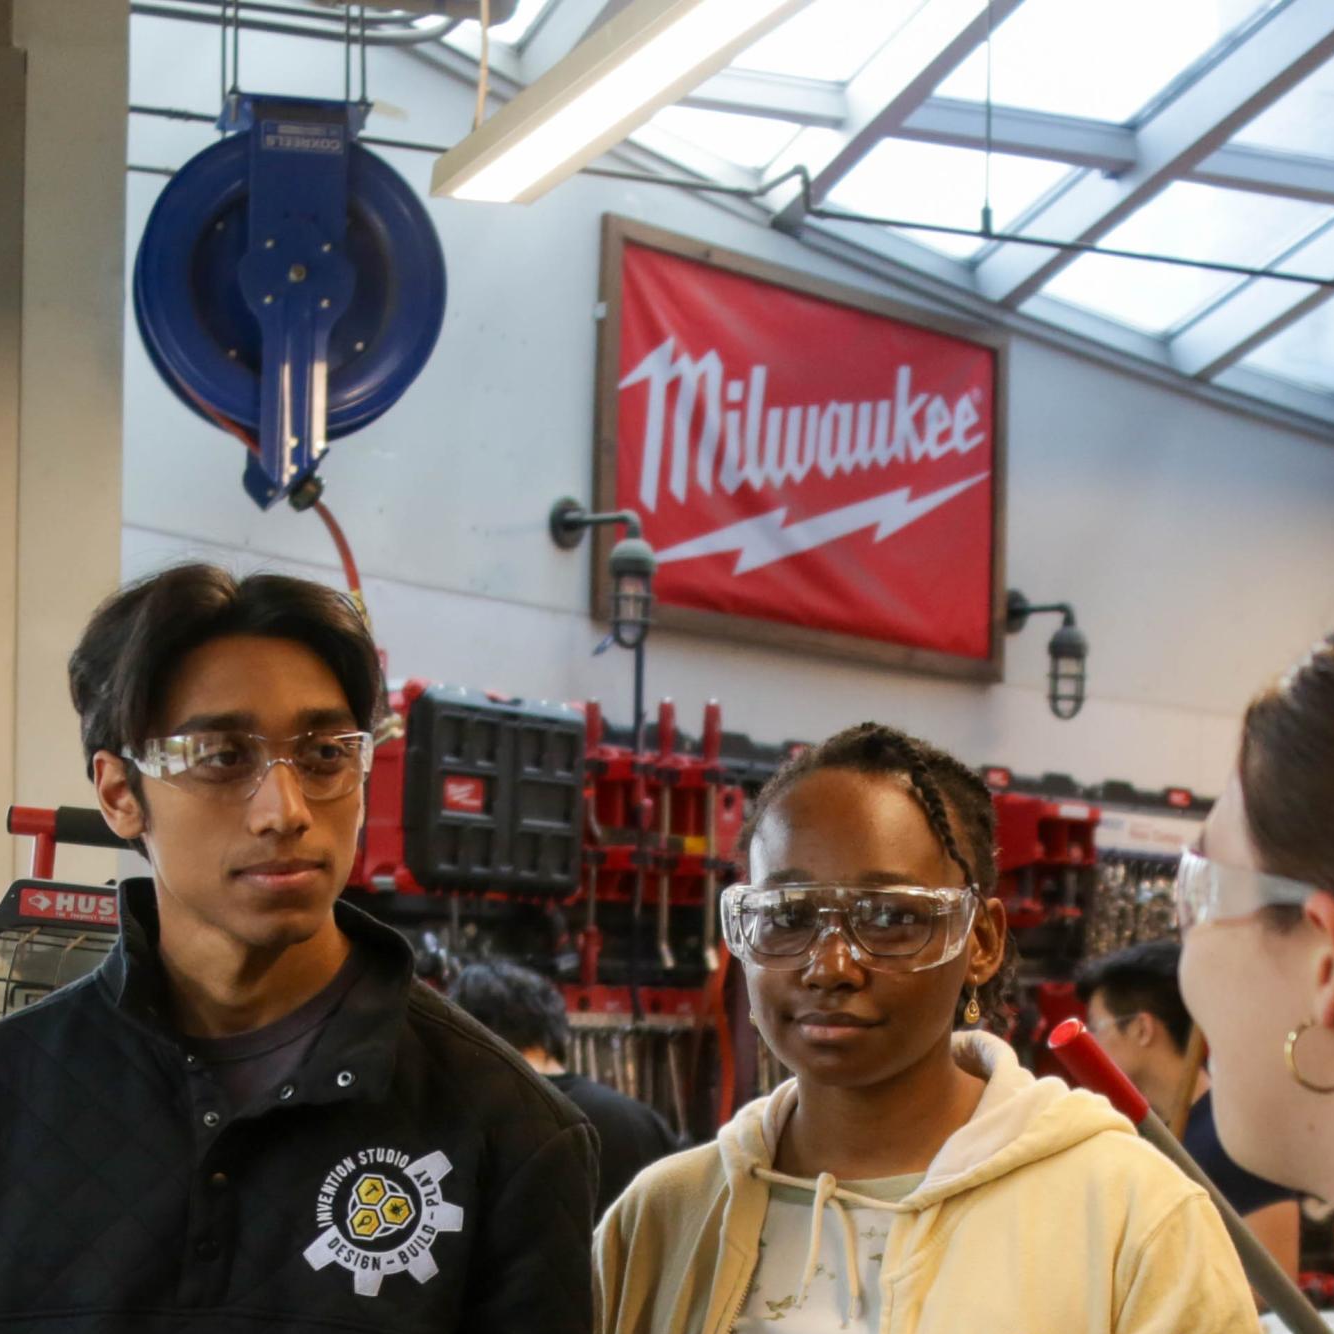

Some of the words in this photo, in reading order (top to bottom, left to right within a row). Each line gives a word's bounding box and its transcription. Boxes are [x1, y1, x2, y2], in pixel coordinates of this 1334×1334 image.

[618, 336, 985, 513] Milwaukee
[317, 1156, 357, 1228] INVENTION
[358, 1147, 410, 1169] STUDIO
[413, 1169, 440, 1207] PLAY
[327, 1236, 382, 1271] DESIGN
[398, 1224, 437, 1265] BUILD
